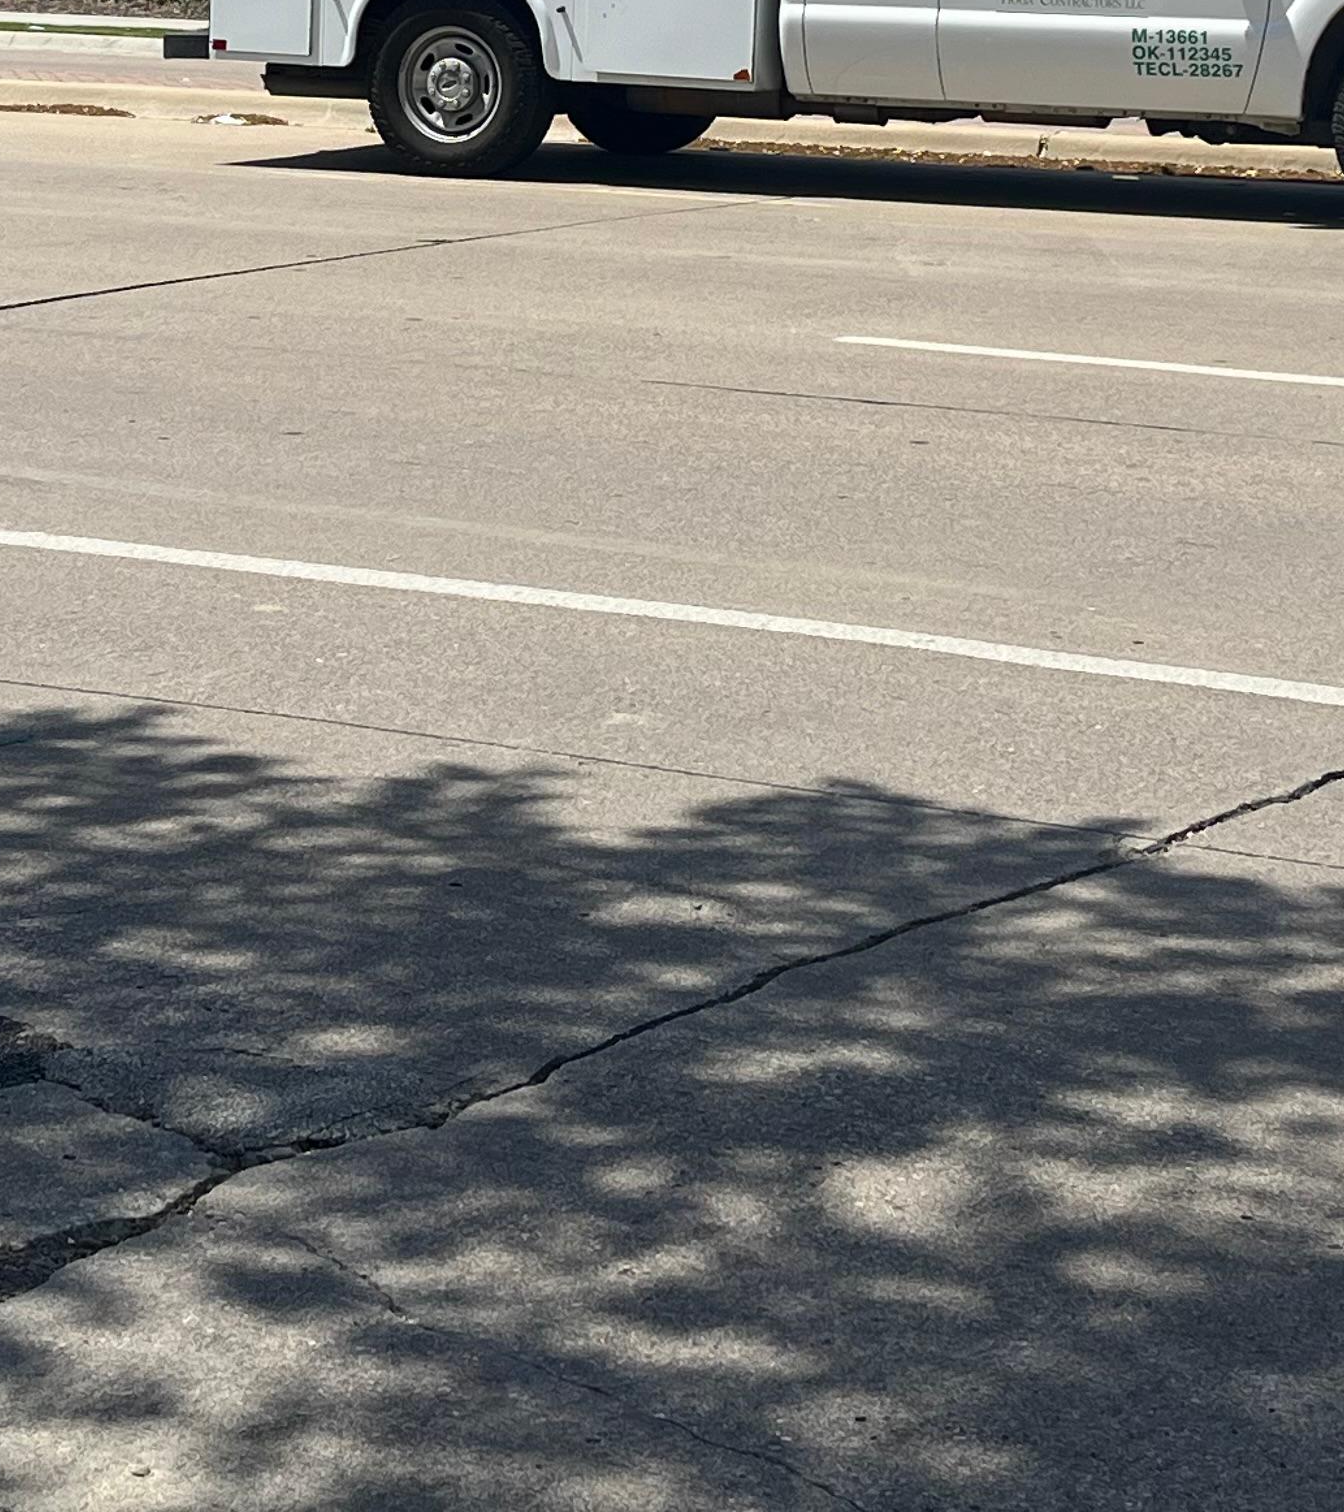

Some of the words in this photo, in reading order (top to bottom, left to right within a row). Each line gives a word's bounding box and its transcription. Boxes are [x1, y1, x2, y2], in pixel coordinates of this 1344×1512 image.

[1131, 28, 1208, 45] M-13661
[1131, 45, 1233, 62] OK-112345
[1133, 62, 1244, 78] TECL-28267
